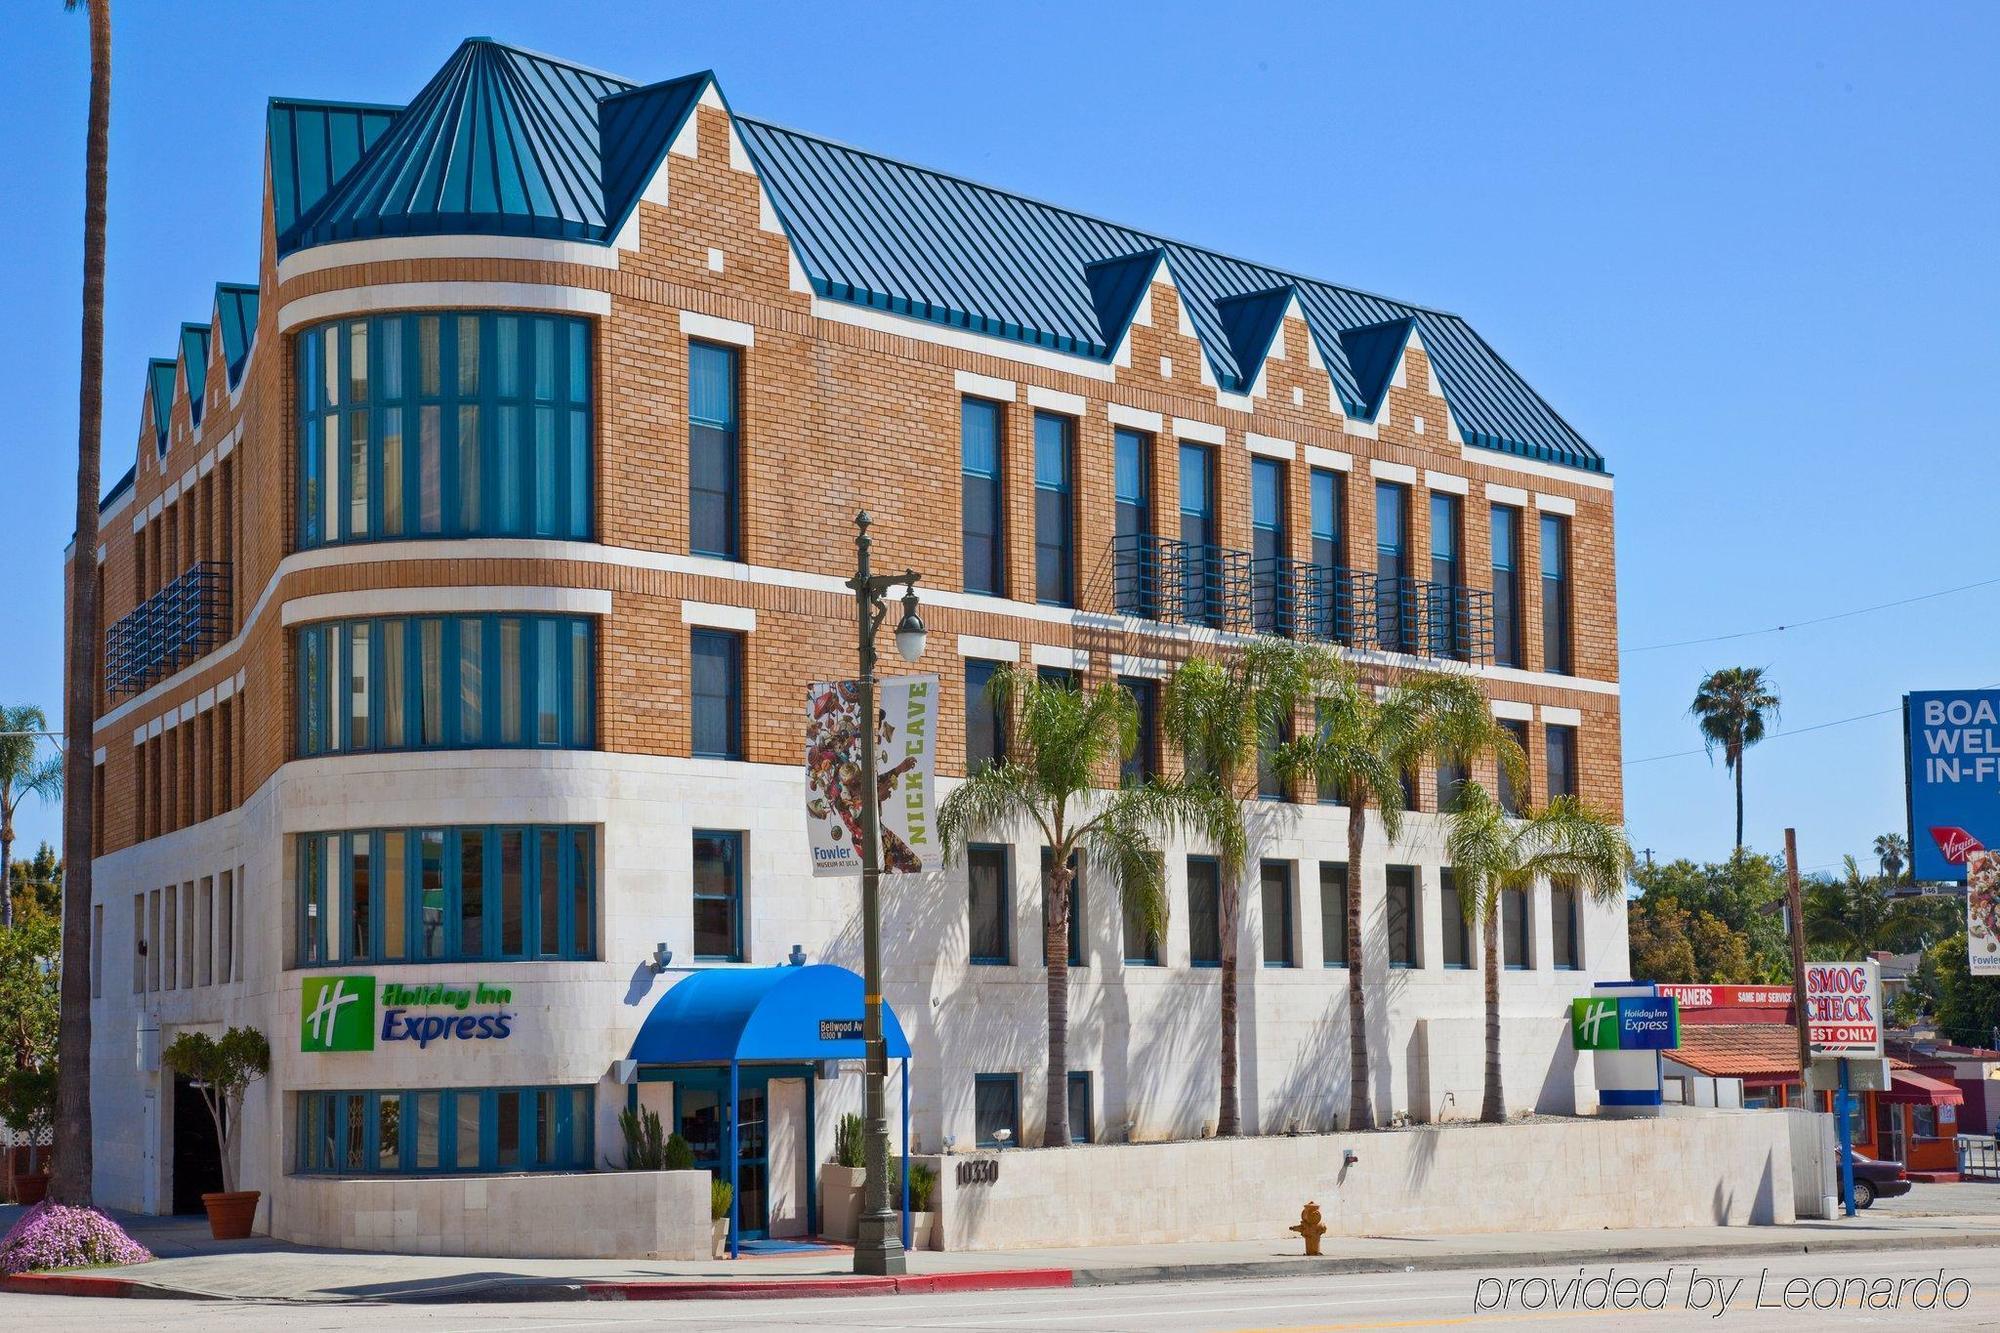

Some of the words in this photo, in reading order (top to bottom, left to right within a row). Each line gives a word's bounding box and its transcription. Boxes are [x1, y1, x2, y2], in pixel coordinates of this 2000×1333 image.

[905, 681, 928, 756] CAVE
[1924, 700, 2000, 726] BOA
[1926, 757, 2000, 783] IN-F
[905, 771, 928, 845] NICK
[814, 845, 851, 860] Fowler
[1943, 832, 1977, 862] Virgin
[1972, 955, 2000, 965] Fowle
[1807, 967, 1867, 994] SMOG
[381, 983, 472, 1010] Holiday
[475, 981, 513, 1005] Inn
[1737, 992, 1755, 1002] SAME
[1755, 992, 1768, 1002] DAY
[1768, 992, 1792, 1002] SERVICE
[820, 1021, 852, 1032] Bellwood
[1624, 1009, 1654, 1019] Holiday
[1654, 1009, 1668, 1017] Inn
[1625, 1019, 1668, 1032] Express
[381, 1009, 512, 1050] Express
[1810, 1028, 1833, 1041] EST
[1836, 1028, 1874, 1041] ONLY
[955, 1160, 999, 1185] 10330
